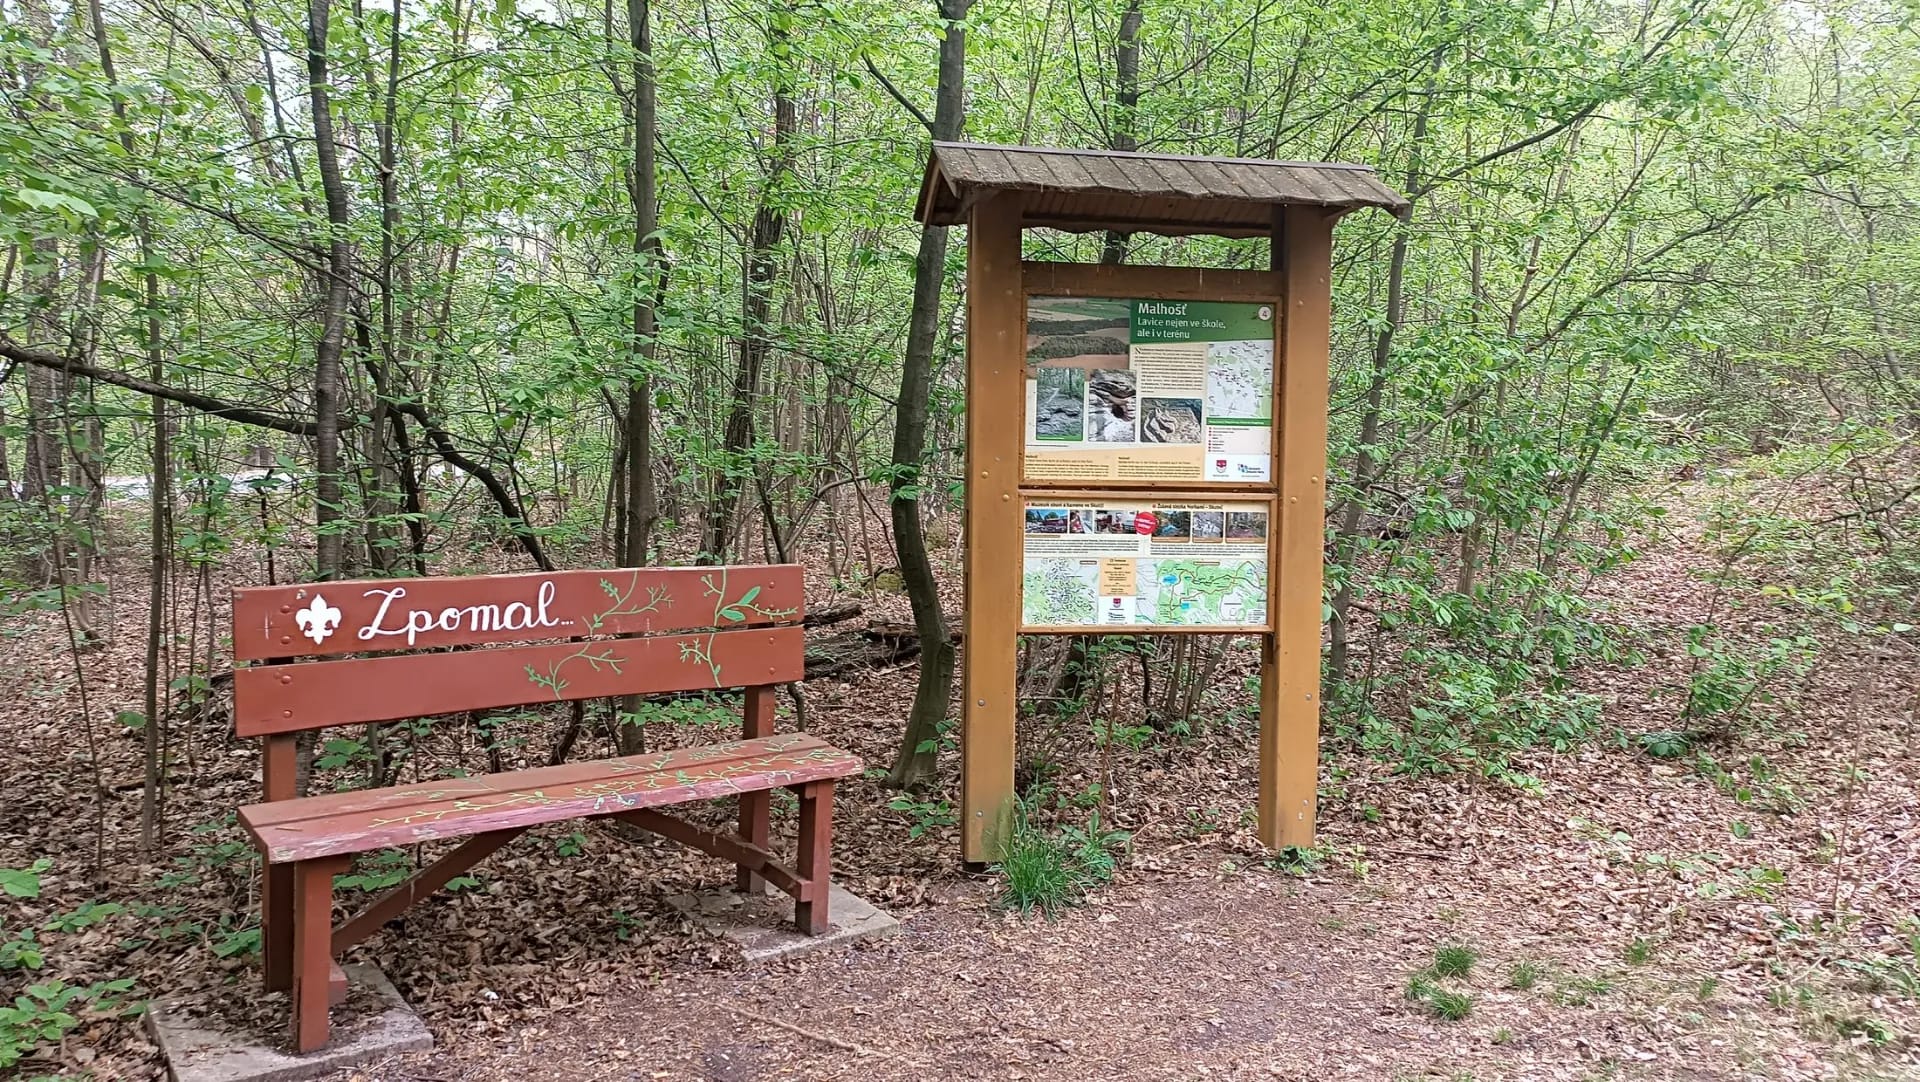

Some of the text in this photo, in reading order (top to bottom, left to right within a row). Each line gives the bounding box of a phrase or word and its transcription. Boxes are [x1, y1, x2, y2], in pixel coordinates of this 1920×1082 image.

[1138, 302, 1187, 316] Malhošť
[1137, 317, 1164, 326] Lavice
[1165, 318, 1189, 328] nejen
[1201, 318, 1226, 329] škole,
[1137, 329, 1151, 337] ale
[1152, 328, 1155, 337] i
[1163, 330, 1190, 339] terénu
